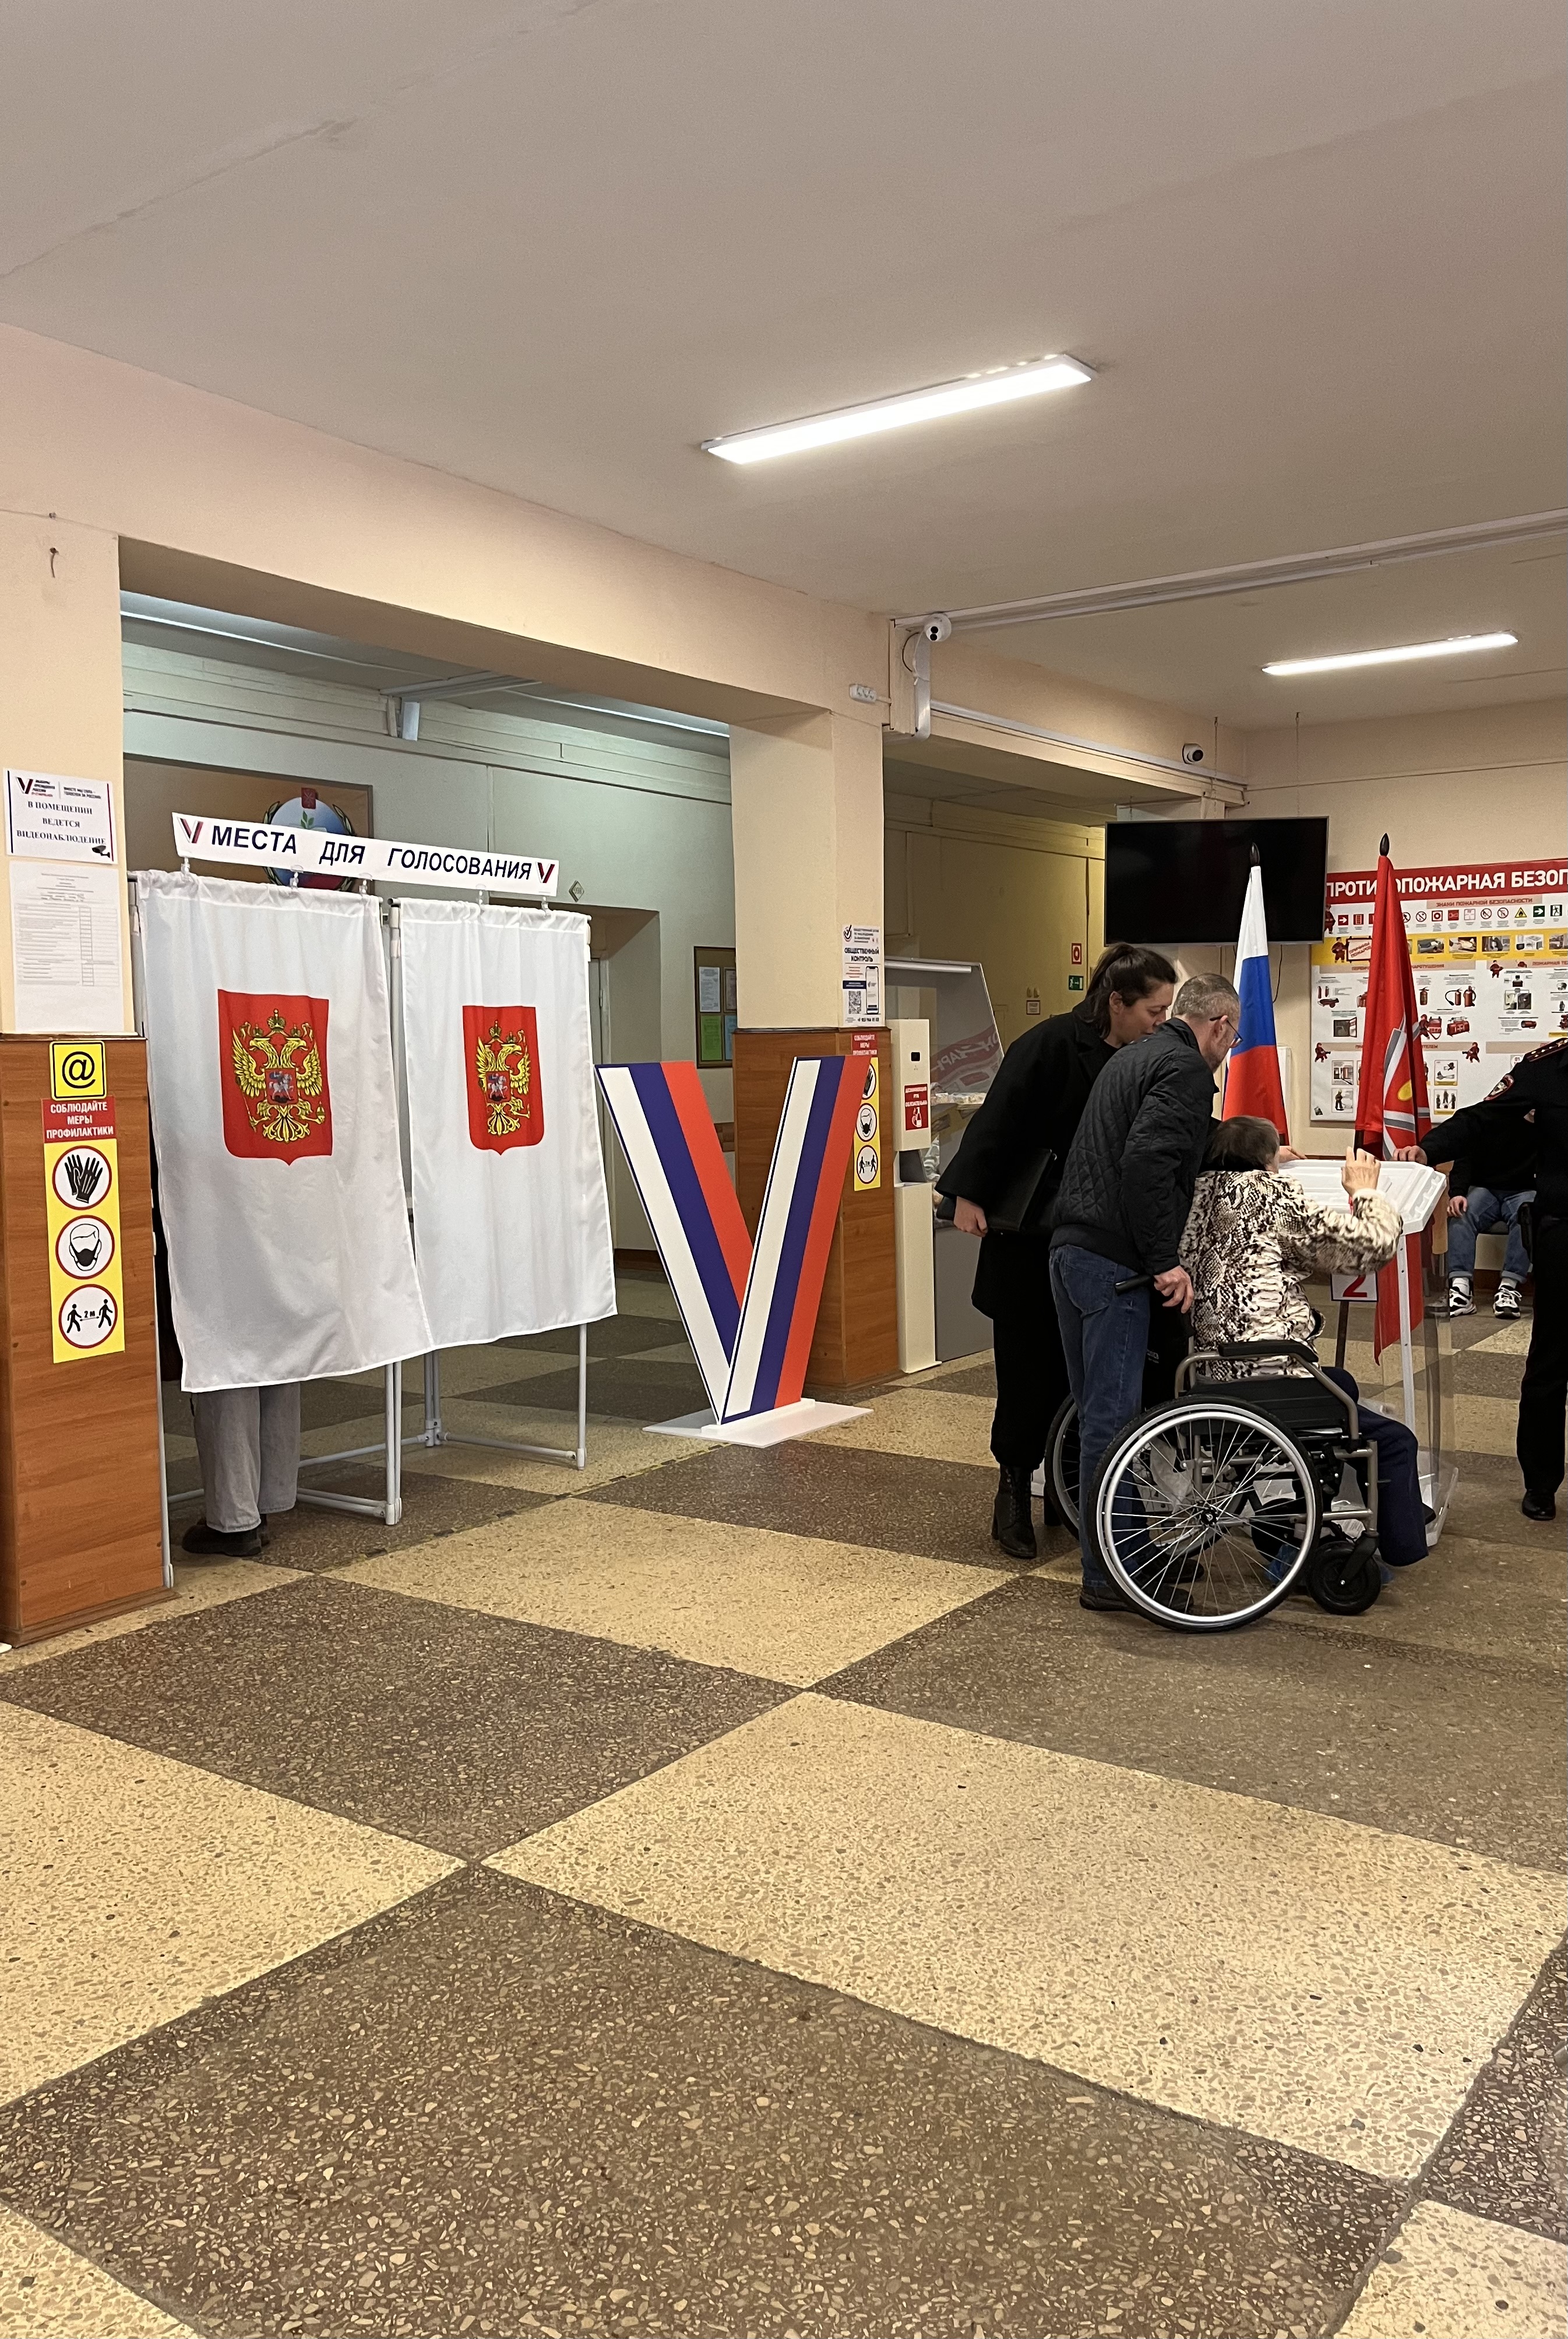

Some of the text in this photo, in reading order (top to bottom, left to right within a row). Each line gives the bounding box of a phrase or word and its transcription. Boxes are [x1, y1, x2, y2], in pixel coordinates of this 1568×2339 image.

[36, 802, 93, 814] ПОМЕЩЕНИИ
[43, 818, 80, 828] ВЕДЕТСЯ
[17, 830, 106, 845] ВИДЕОНАБЛЮДЕНИЕ
[212, 825, 297, 854] МЕСТА
[319, 841, 365, 866] ДЛЯ
[387, 848, 532, 880] ГОЛОСОВАНИЯ
[50, 1100, 108, 1113] СОБЛЮДАЙТЕ
[67, 1114, 93, 1125] МЕРЫ
[46, 1125, 114, 1139] ПРОФИЛАКТИКИ
[1343, 1274, 1368, 1298] 2
